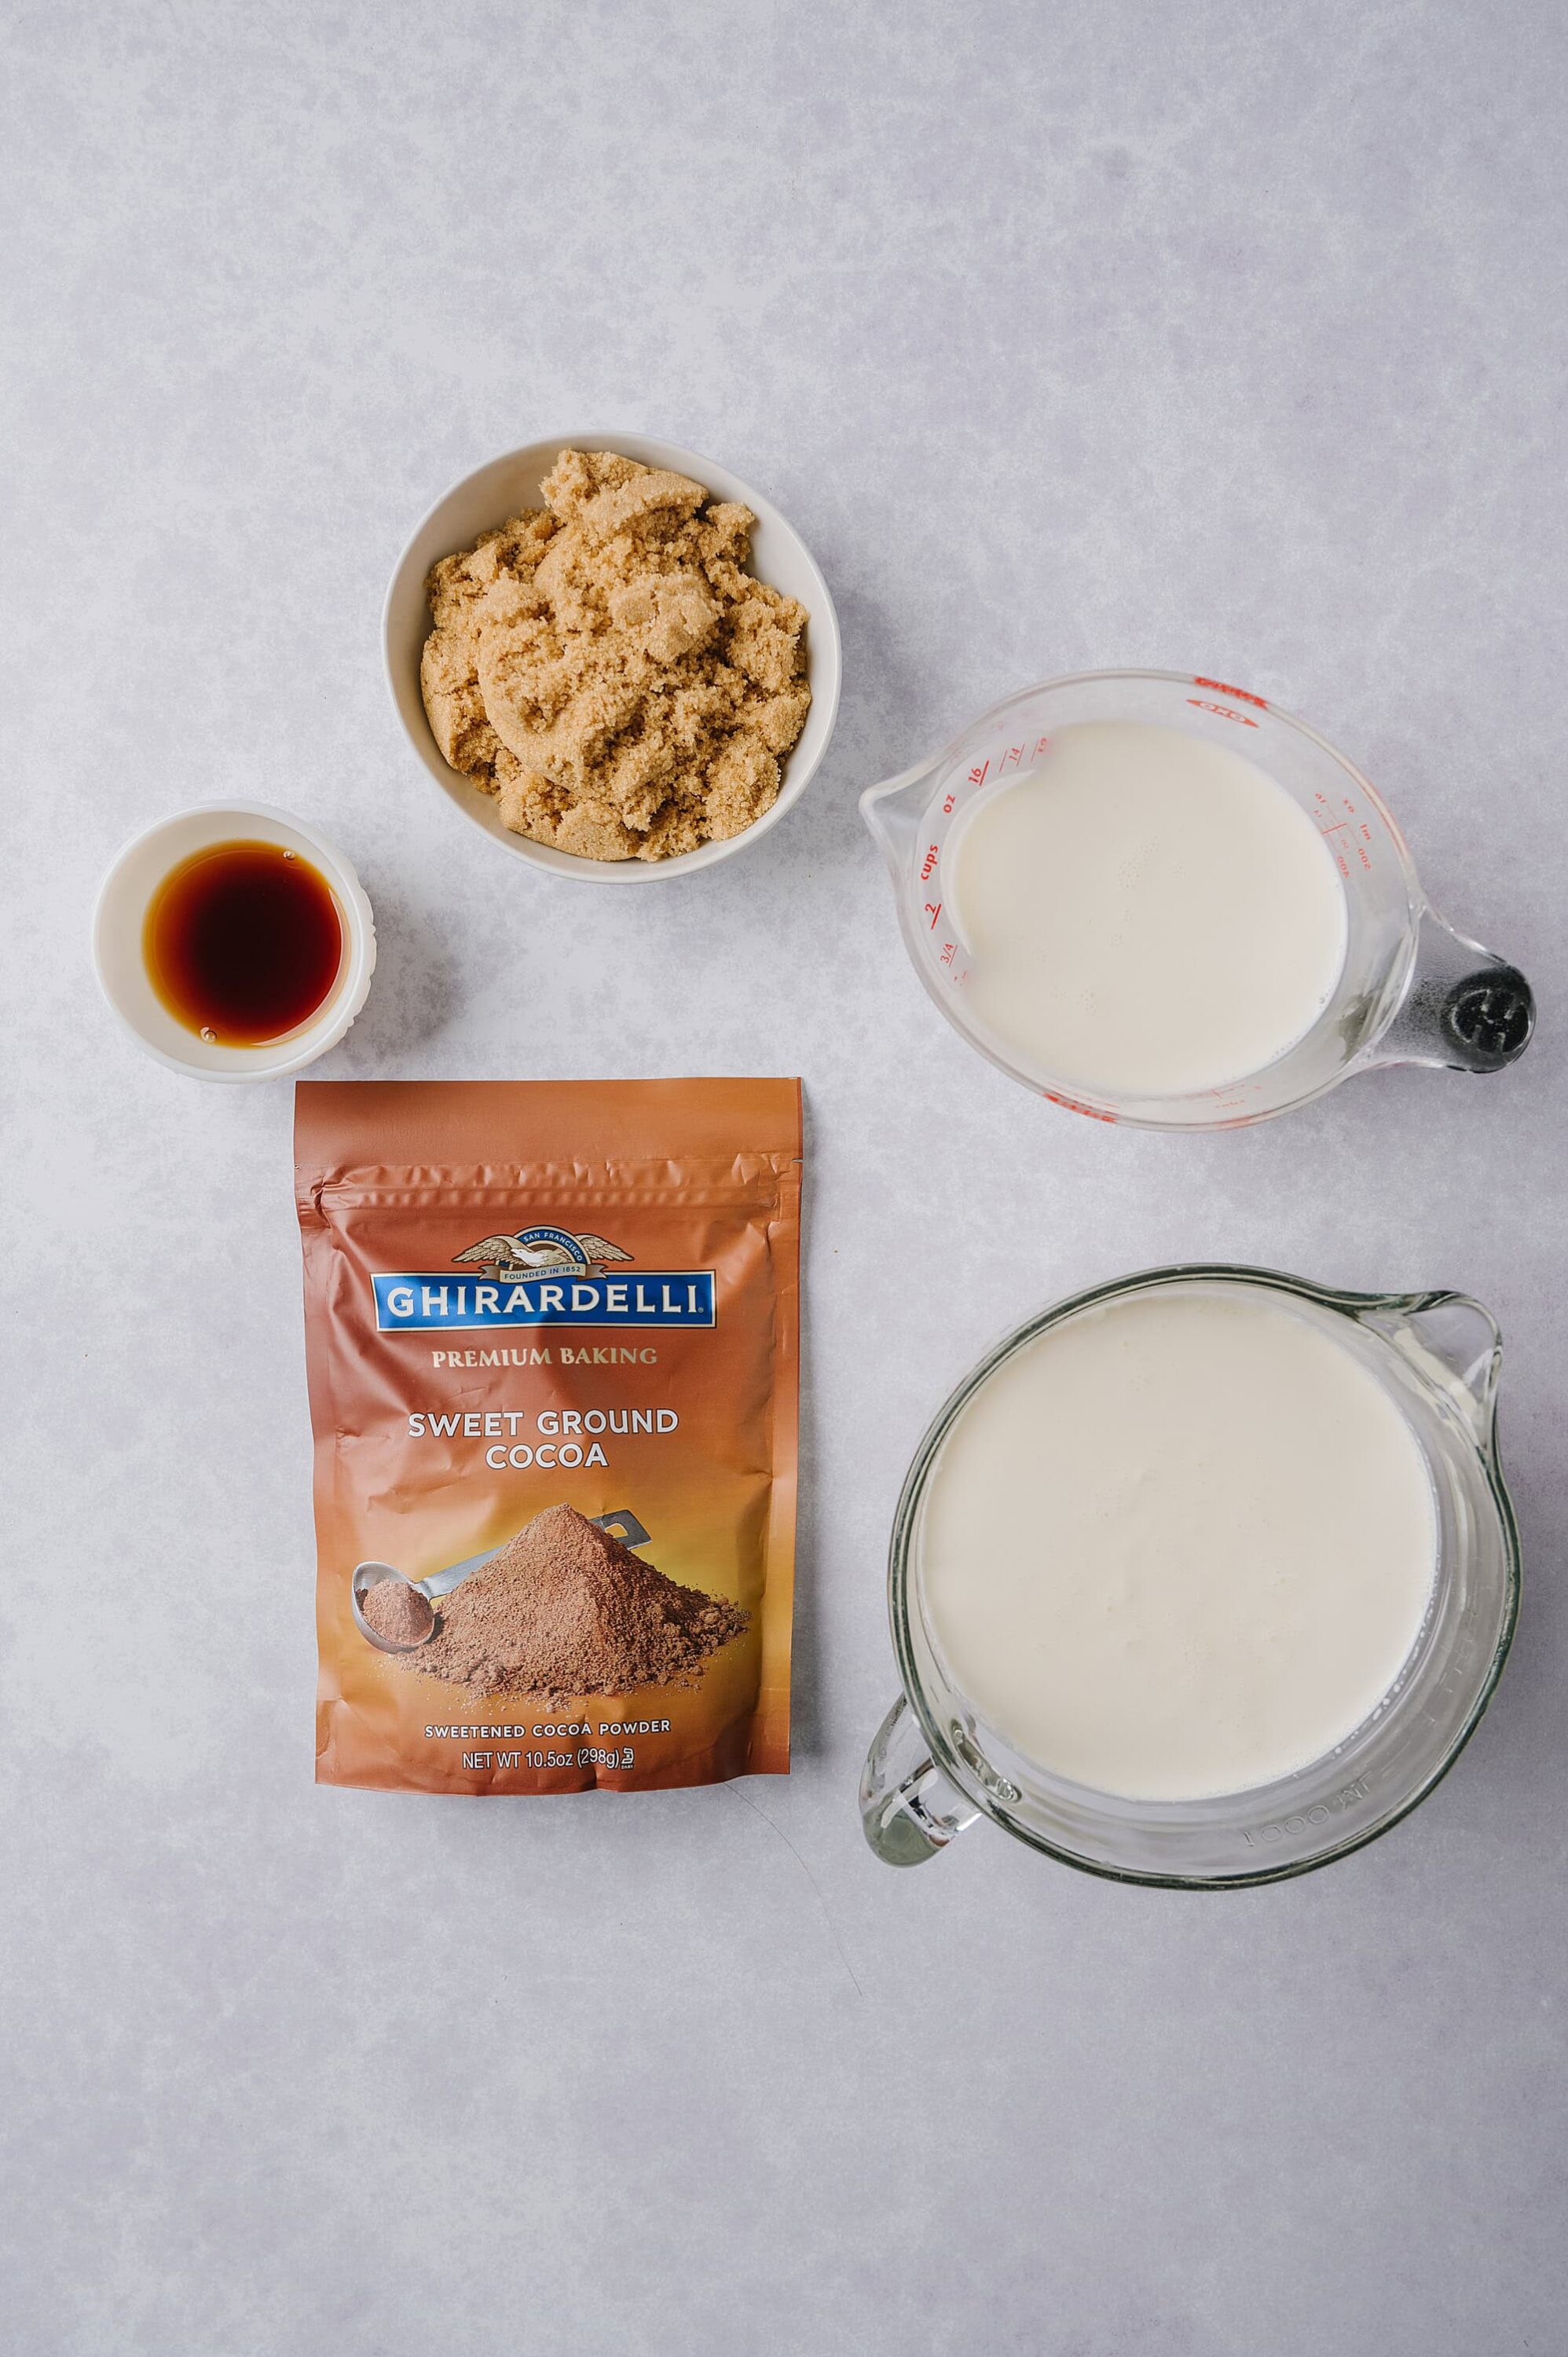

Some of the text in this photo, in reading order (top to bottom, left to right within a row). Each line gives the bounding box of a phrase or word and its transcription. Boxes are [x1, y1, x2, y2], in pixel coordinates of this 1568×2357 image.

[967, 768, 982, 784] 16
[943, 794, 956, 814] oz
[920, 844, 939, 881] cups
[940, 943, 954, 964] 3/4
[523, 1232, 583, 1261] SAN FRANCISCO
[504, 1270, 547, 1280] FOUNDED
[431, 1347, 658, 1369] PREMIUM BAKING
[408, 1409, 680, 1438] SWEET GROUND
[485, 1442, 610, 1469] COCOA
[424, 1719, 671, 1738] SWEETENED COCOA POWDER
[463, 1747, 619, 1769] NET WT 10.5oz (298g)
